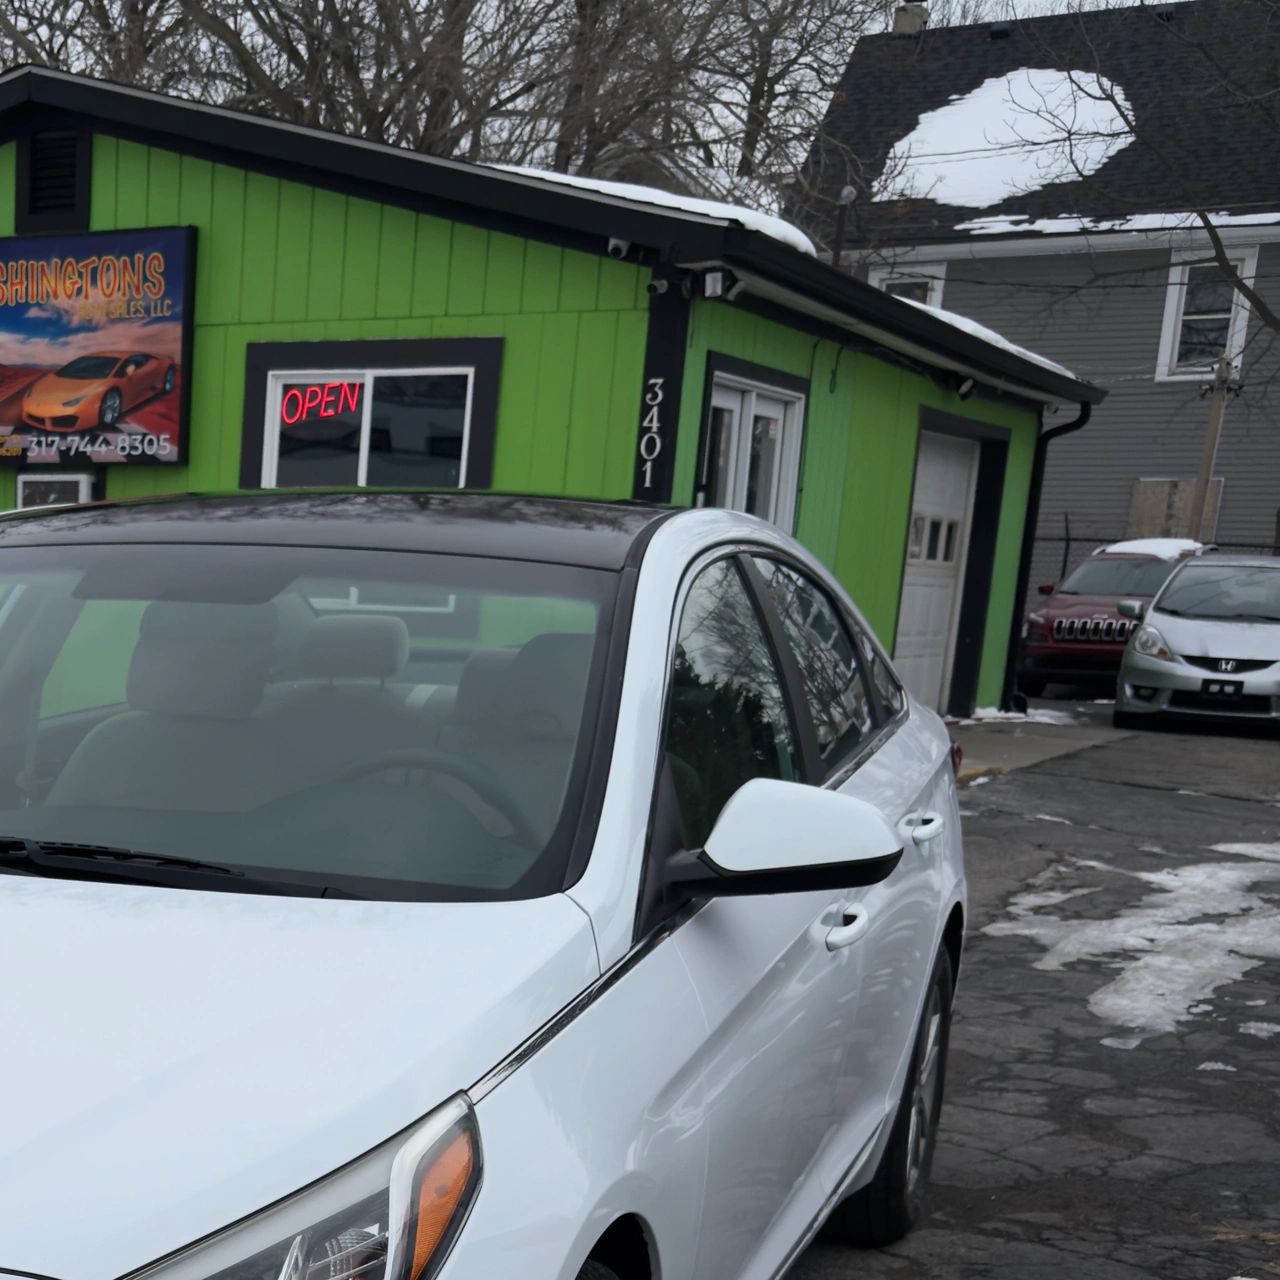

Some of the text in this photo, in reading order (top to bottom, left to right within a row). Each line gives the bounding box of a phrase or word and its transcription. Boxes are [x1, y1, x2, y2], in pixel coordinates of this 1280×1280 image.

[150, 299, 172, 317] LLC
[281, 380, 360, 425] OPEN
[26, 434, 170, 457] 317-744-8305
[640, 378, 664, 488] 3401
